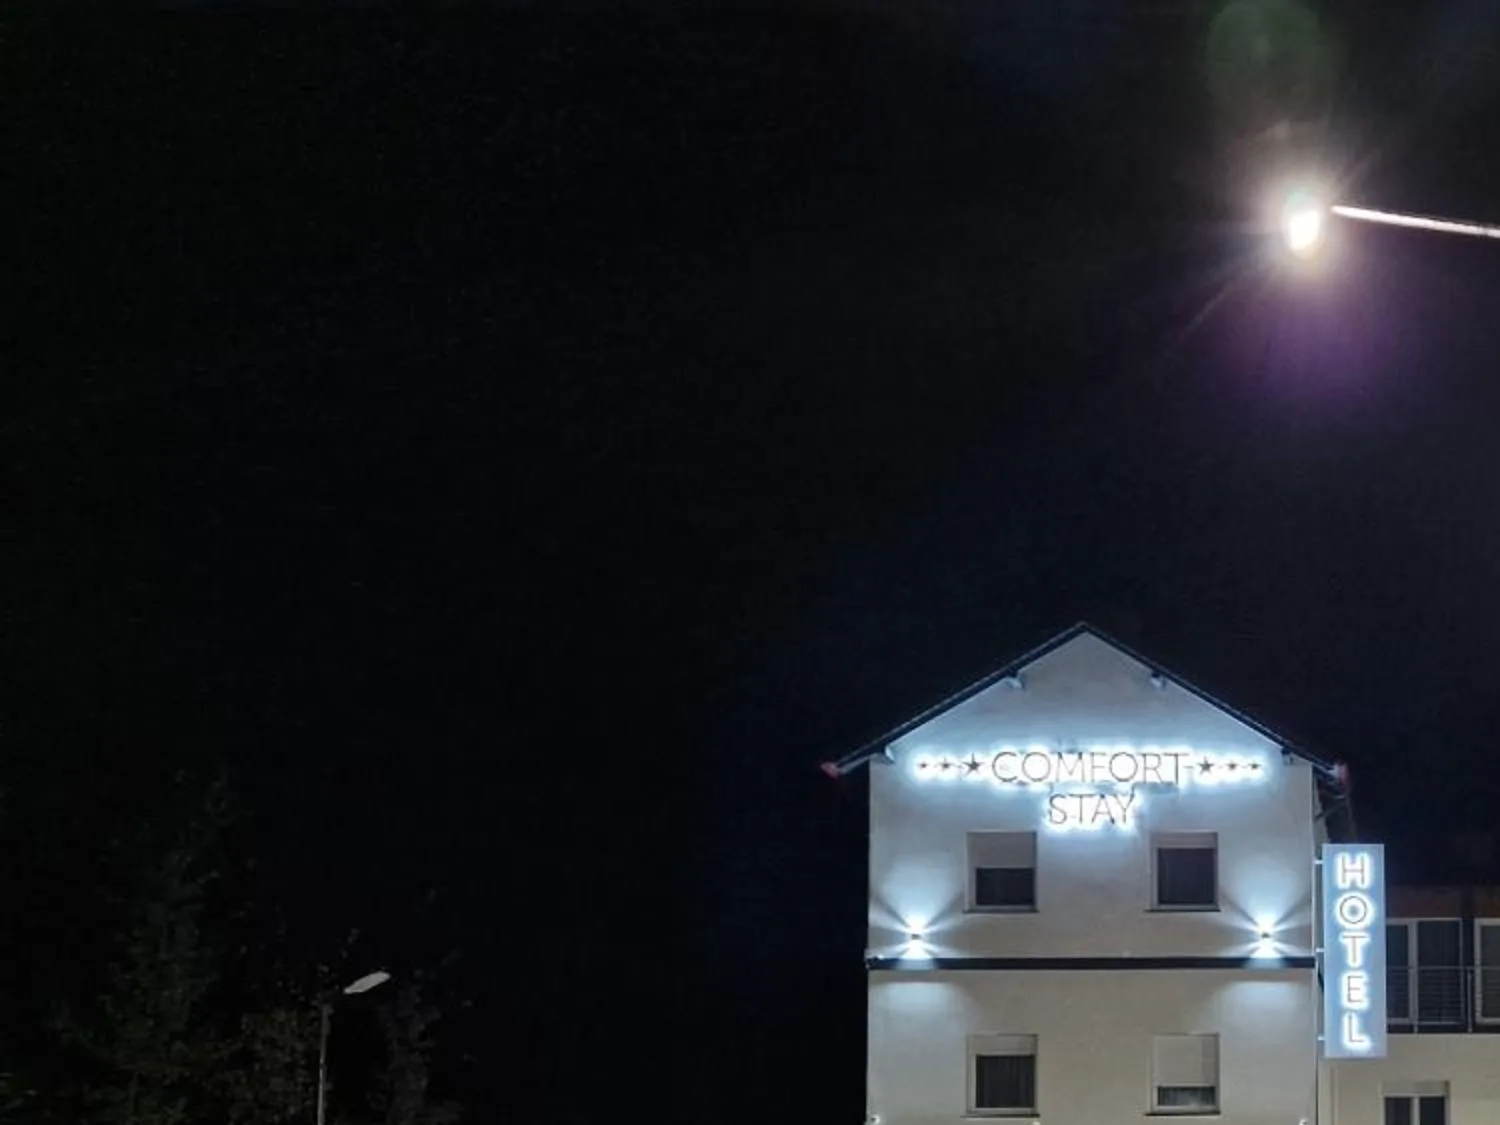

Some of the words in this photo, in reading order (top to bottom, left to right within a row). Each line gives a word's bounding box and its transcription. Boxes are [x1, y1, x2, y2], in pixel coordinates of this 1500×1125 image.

[991, 750, 1190, 785] COMFORT
[1047, 792, 1136, 826] STAY
[1336, 852, 1368, 1045] HOTEL
